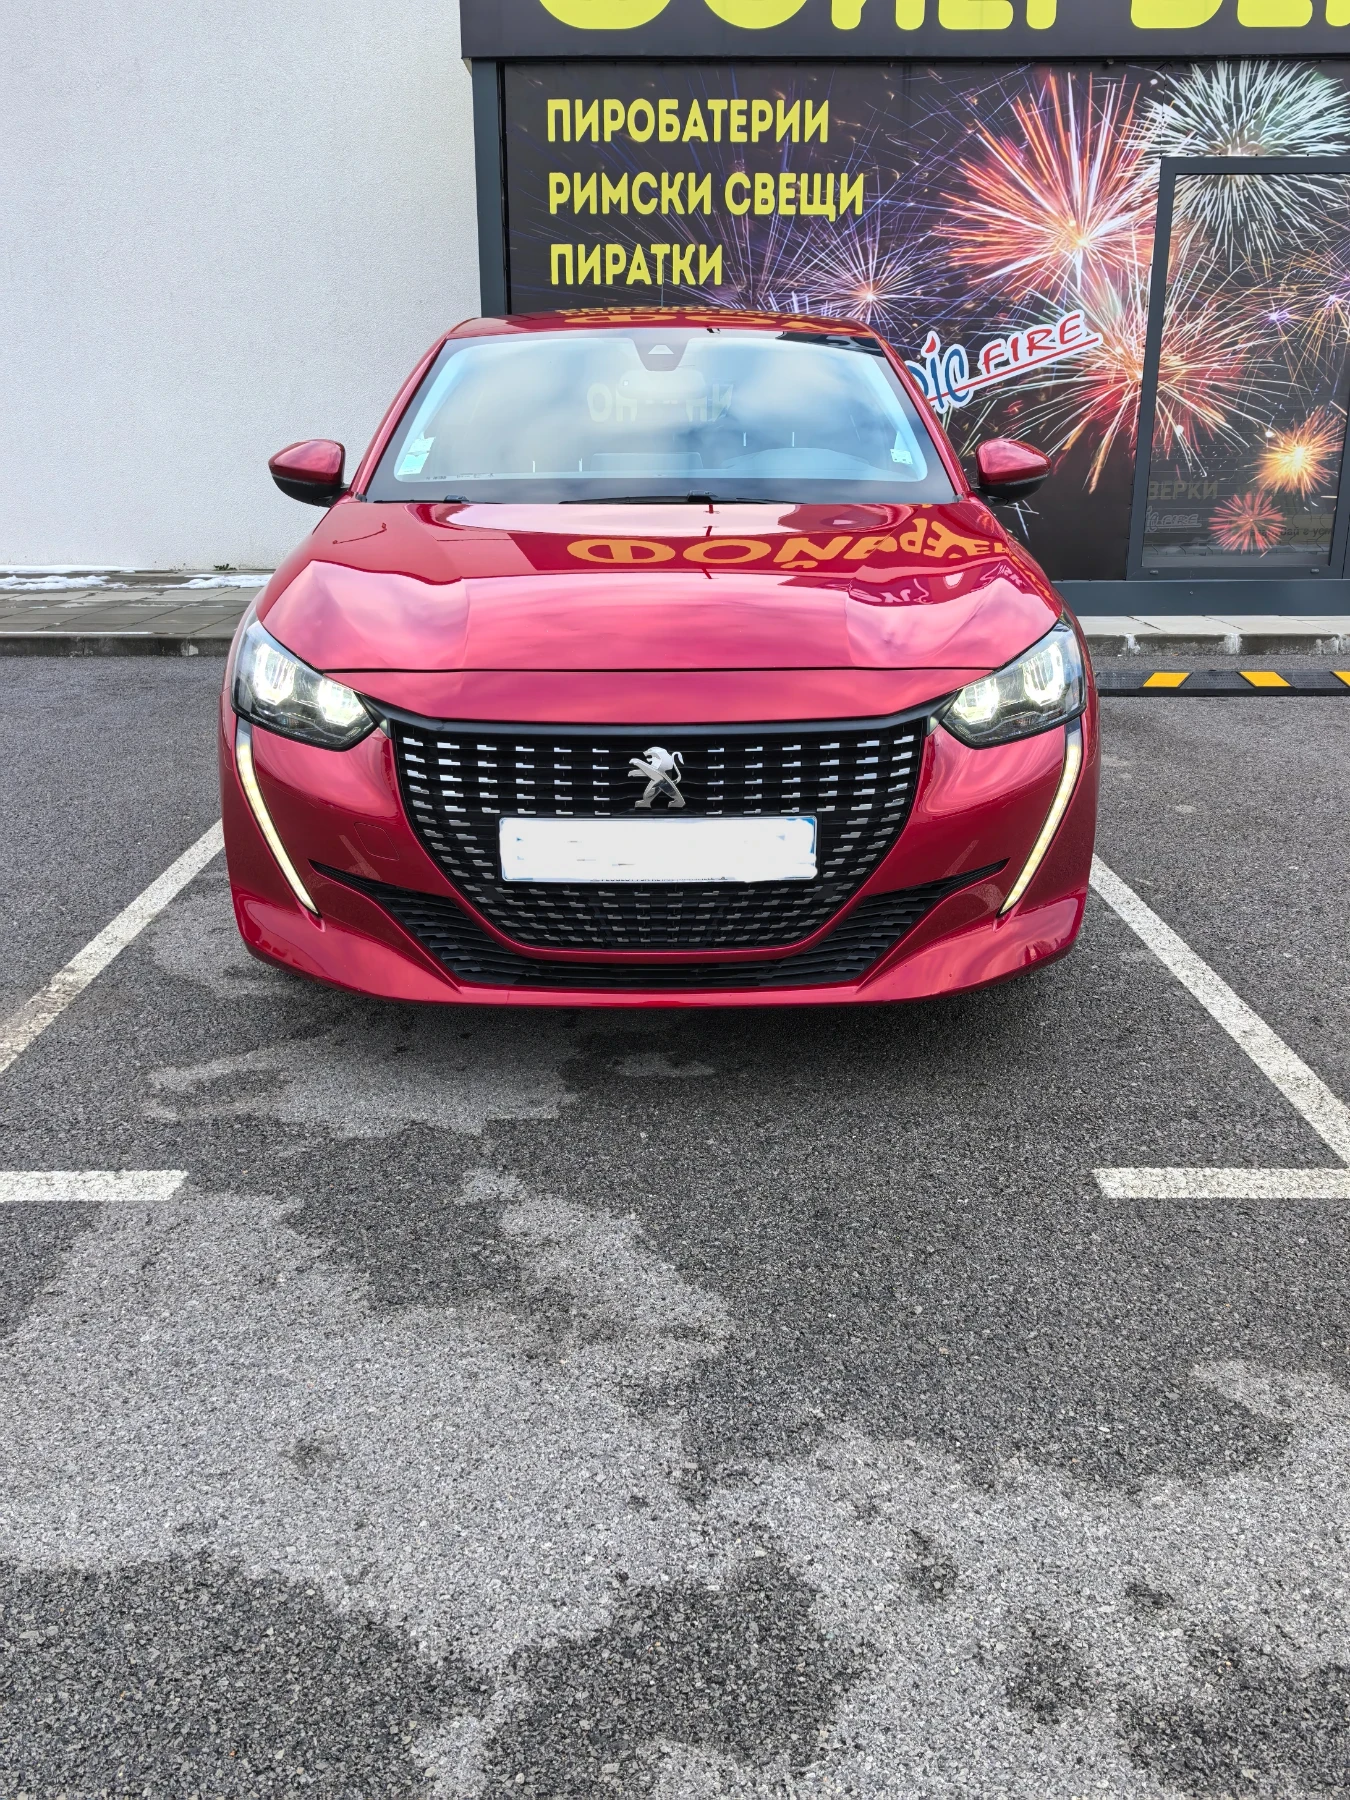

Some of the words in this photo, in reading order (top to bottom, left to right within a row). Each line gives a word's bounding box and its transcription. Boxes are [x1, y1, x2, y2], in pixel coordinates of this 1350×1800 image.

[547, 98, 829, 143] ПИРОБАТЕРИИ
[548, 172, 712, 215] РИМСКИ
[724, 172, 864, 222] СВЕЩИ
[550, 244, 723, 286] ПИРАТКИ
[981, 313, 1083, 375] FIRE
